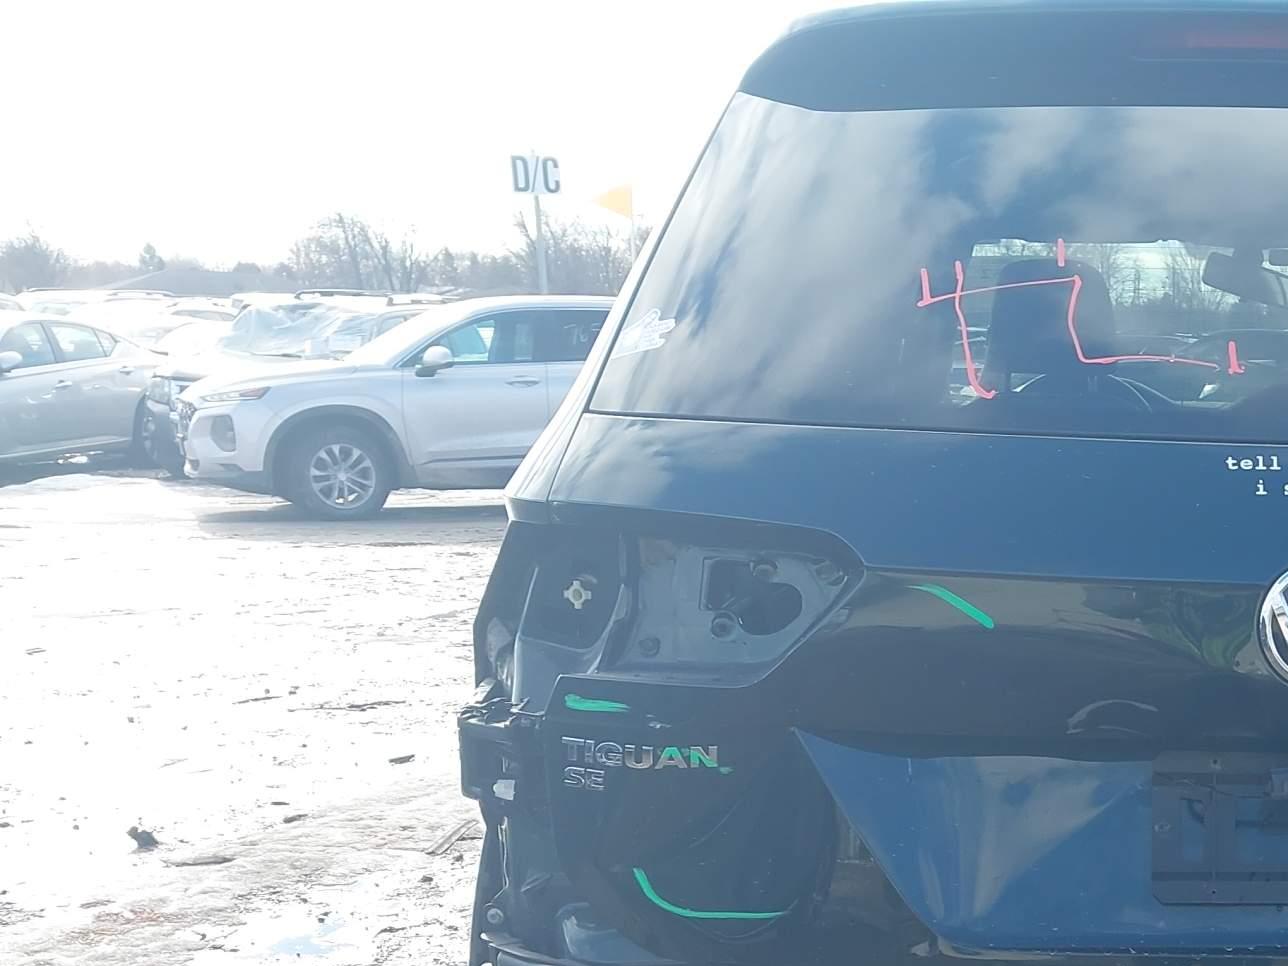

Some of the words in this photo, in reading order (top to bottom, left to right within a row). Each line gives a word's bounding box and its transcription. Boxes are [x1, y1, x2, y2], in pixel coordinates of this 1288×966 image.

[511, 155, 560, 193] D/C
[1225, 455, 1282, 471] tell
[1255, 479, 1268, 496] i
[561, 736, 719, 770] TIGUAN
[563, 766, 606, 791] SE
